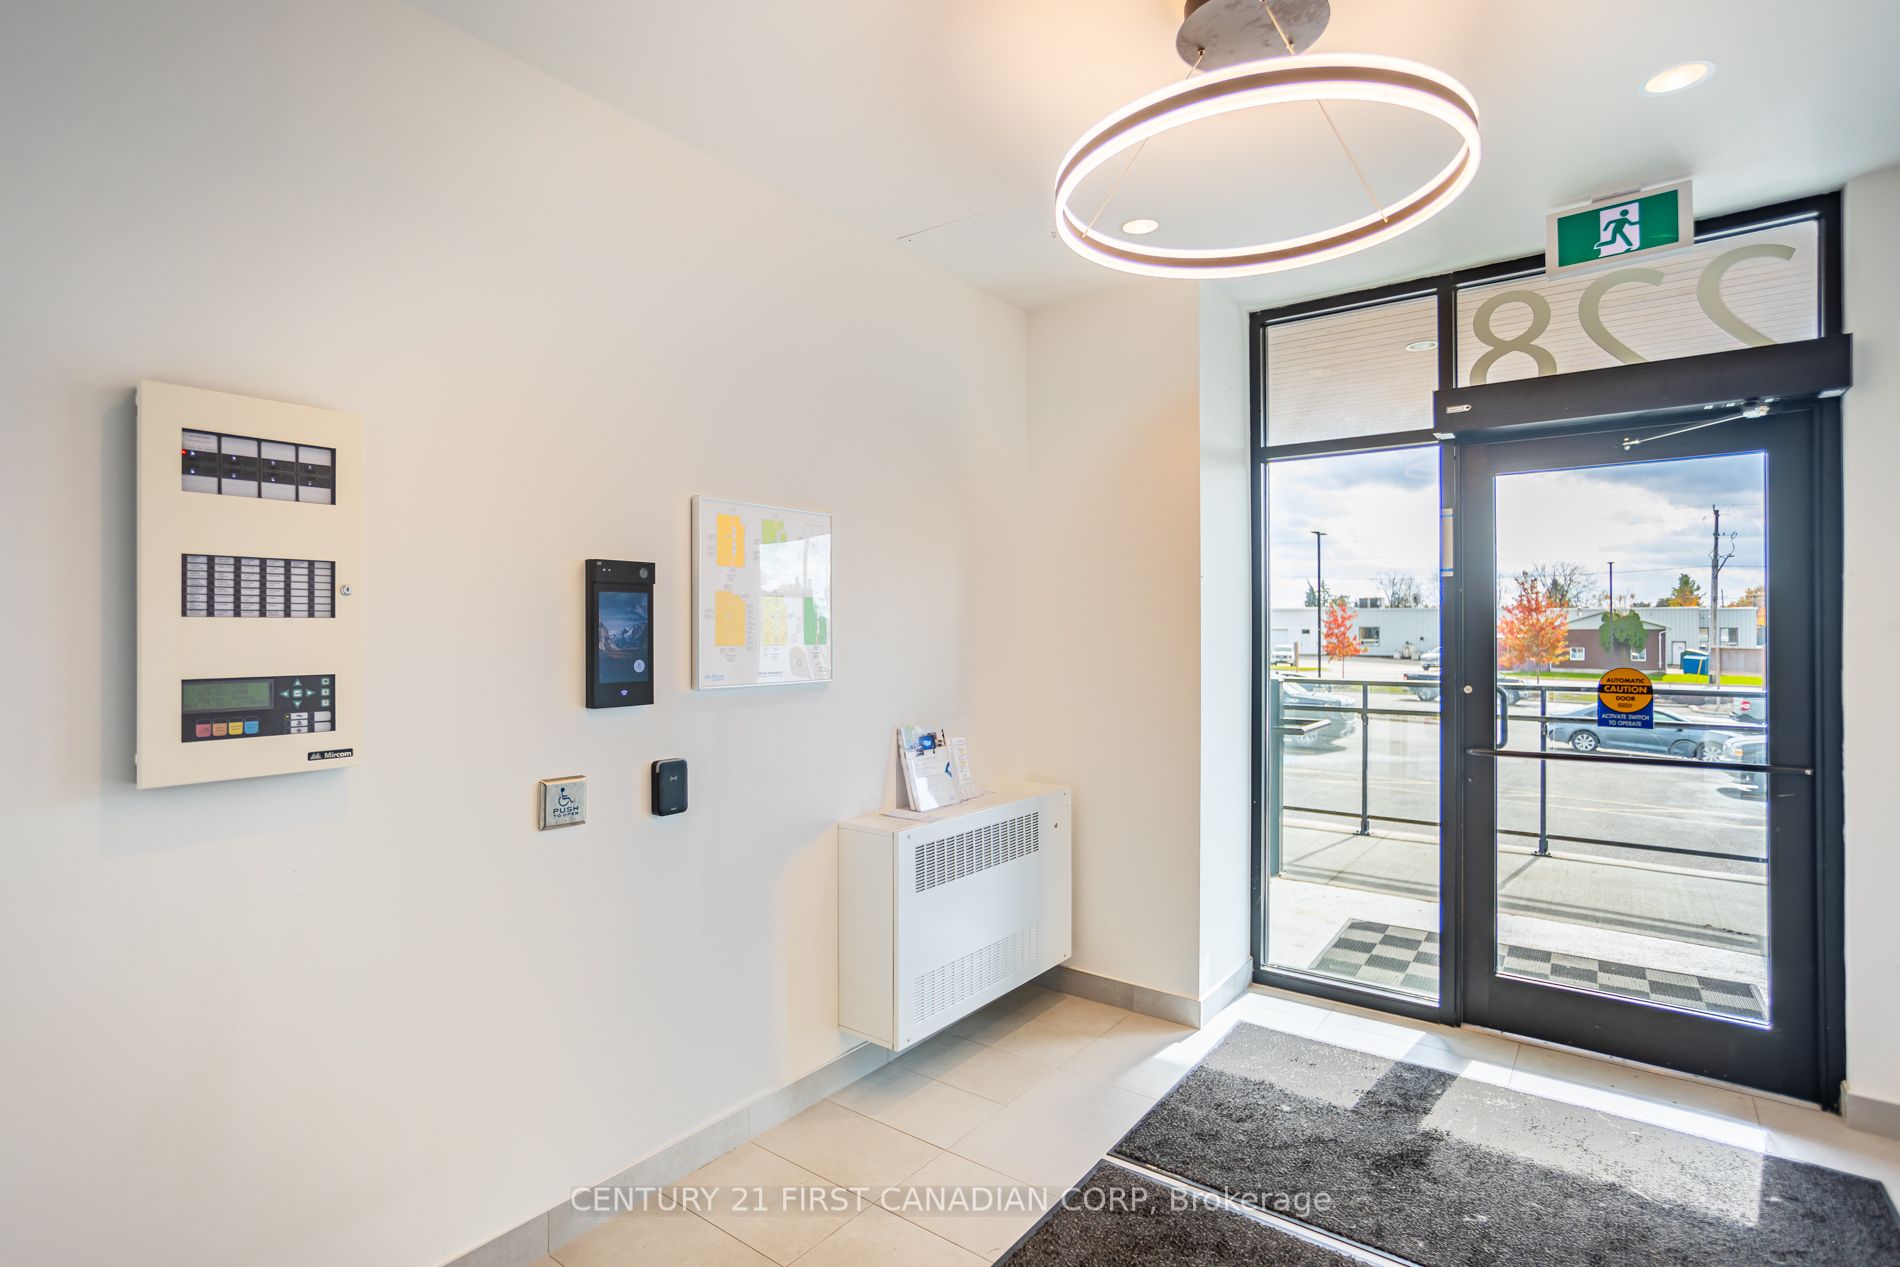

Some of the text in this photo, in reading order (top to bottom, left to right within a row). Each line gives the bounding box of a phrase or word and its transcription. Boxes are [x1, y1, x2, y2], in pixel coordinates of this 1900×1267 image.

[1603, 685, 1647, 693] CAUTION
[324, 751, 352, 759] Mircom
[552, 806, 579, 814] PUSH
